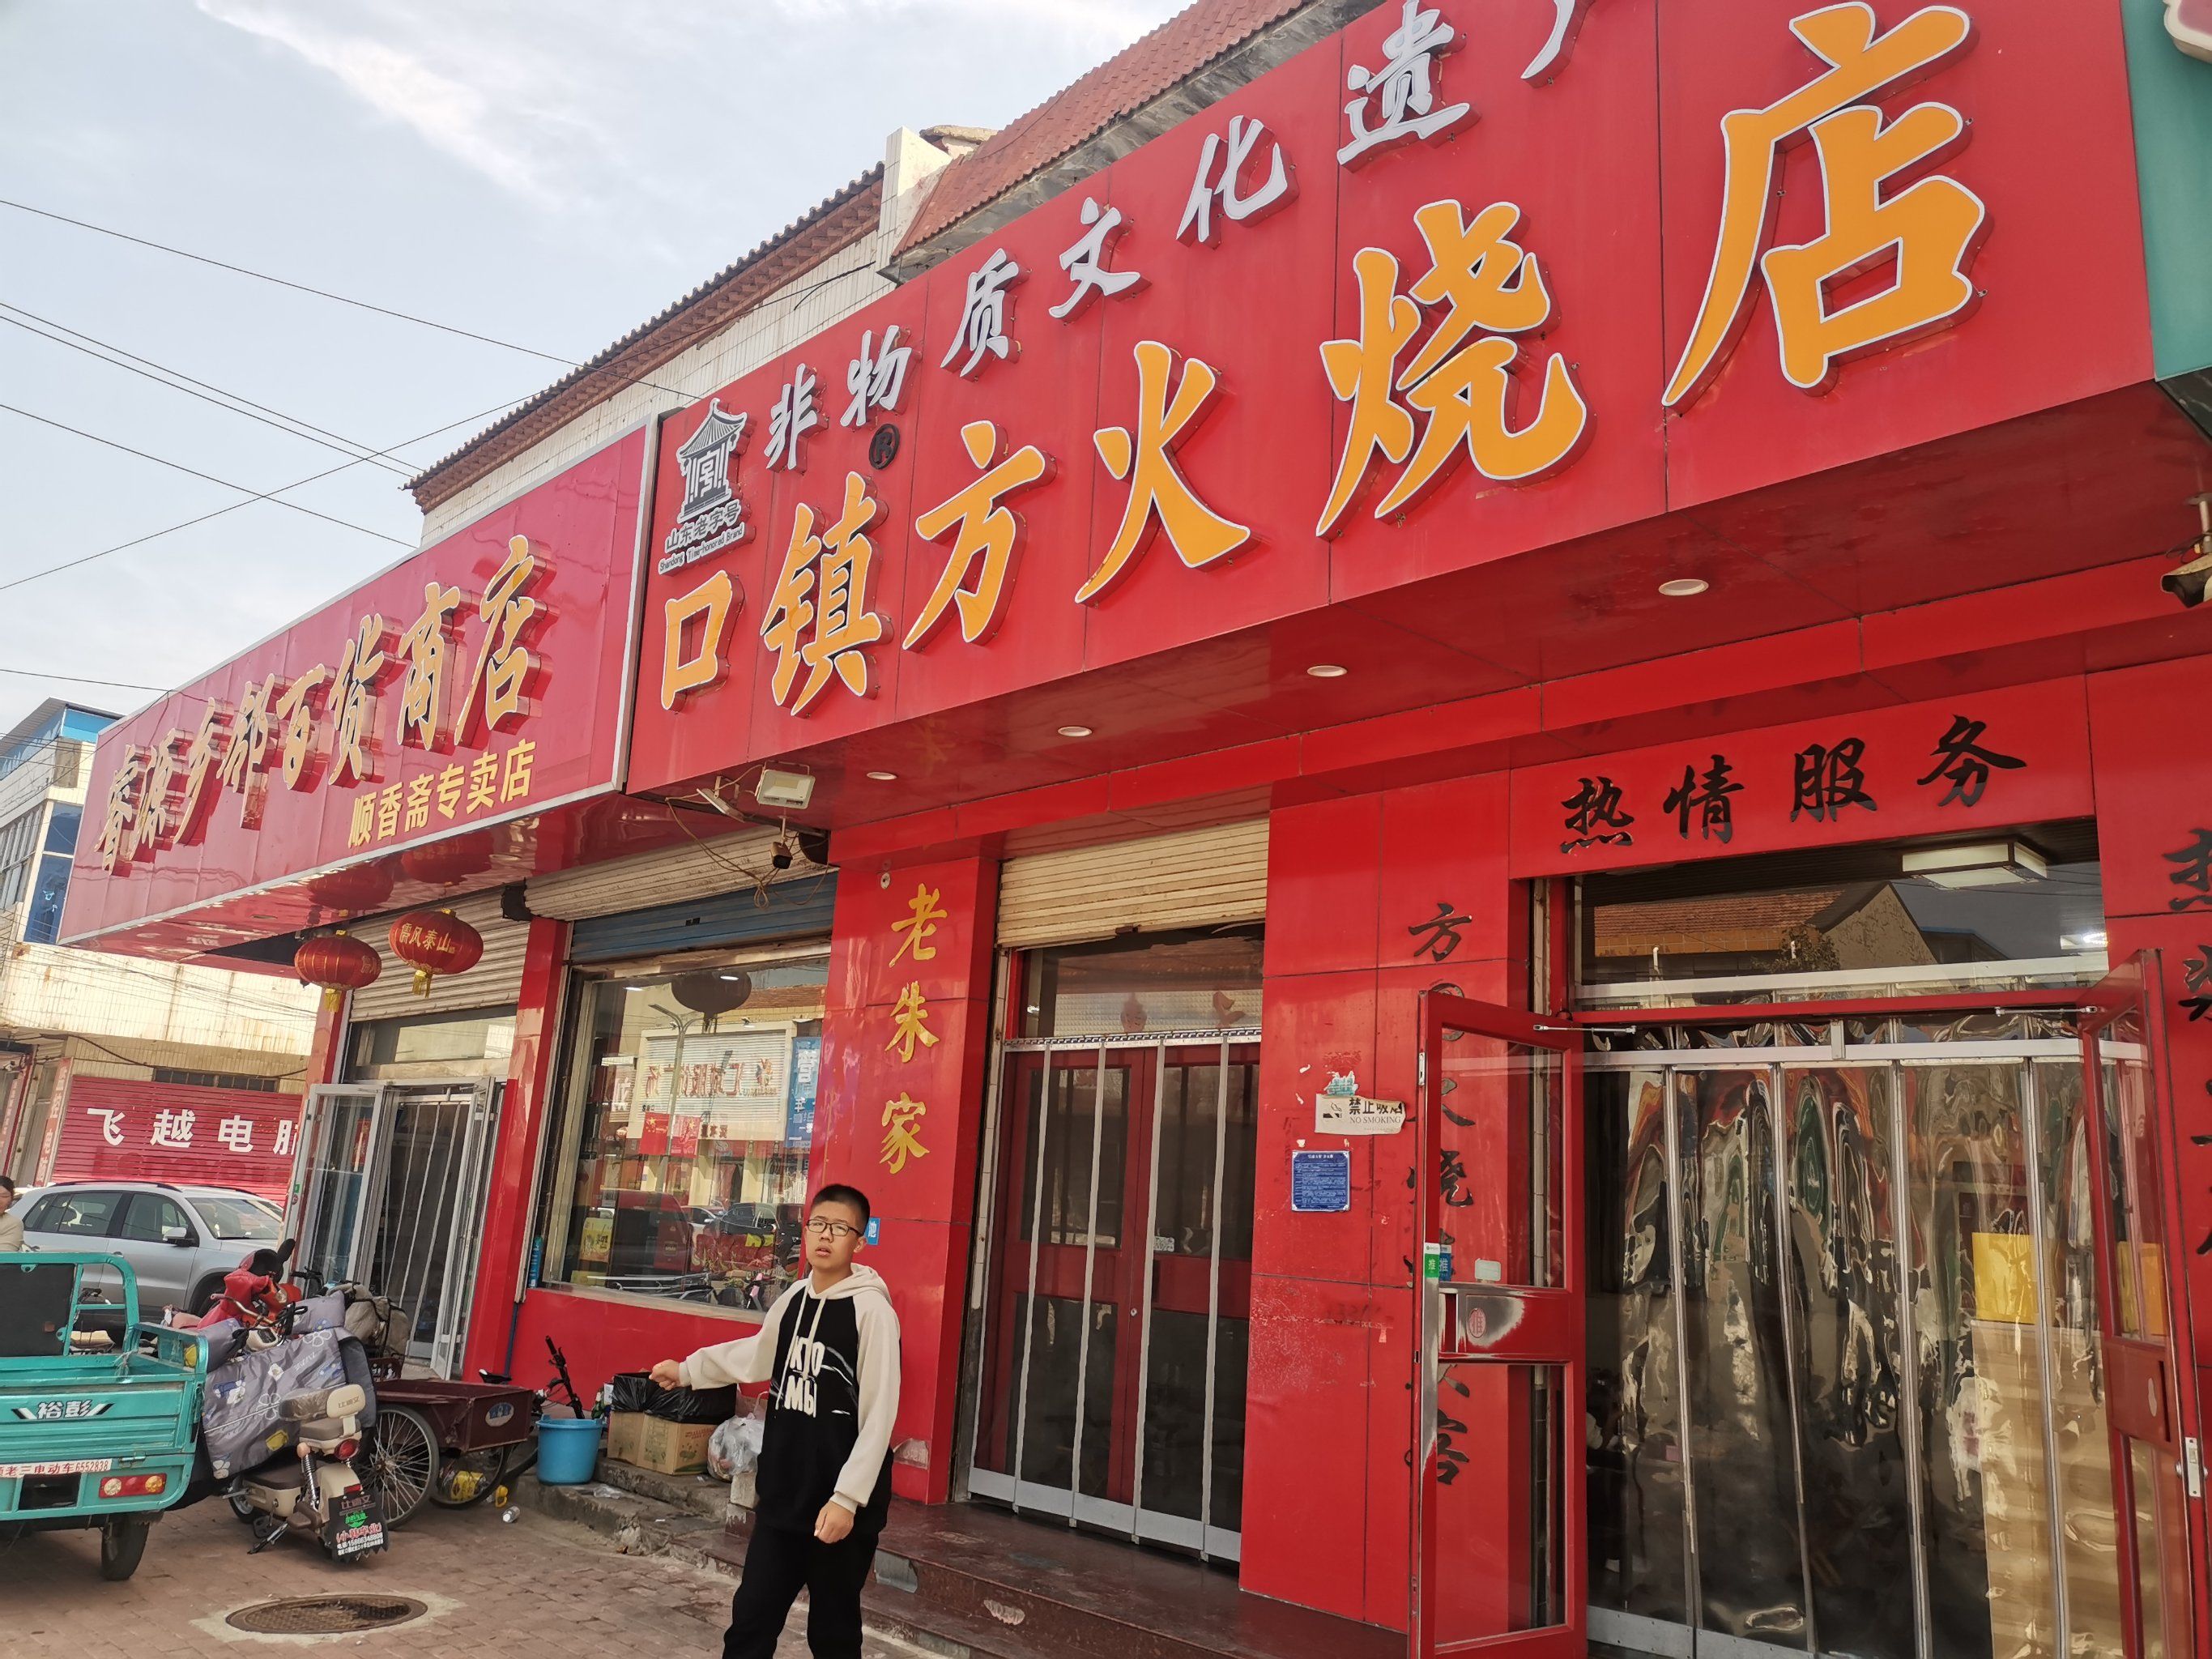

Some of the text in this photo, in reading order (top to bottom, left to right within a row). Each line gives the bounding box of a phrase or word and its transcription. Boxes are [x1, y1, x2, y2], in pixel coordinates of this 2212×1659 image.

[764, 0, 1577, 470] 非物质文化遗
[660, 2, 1985, 717] 口镇方火烧店
[659, 527, 744, 572] Shandong Time-honored Brand
[666, 501, 740, 551] 山东老字号
[348, 739, 536, 849] 顺香斋专卖店
[1560, 714, 2027, 854] 热情服务
[399, 923, 451, 952] 儒风泰山
[879, 883, 948, 1175] 老朱家
[1349, 1115, 1402, 1124] NO SMOKING
[36, 1399, 92, 1419] 裕彭
